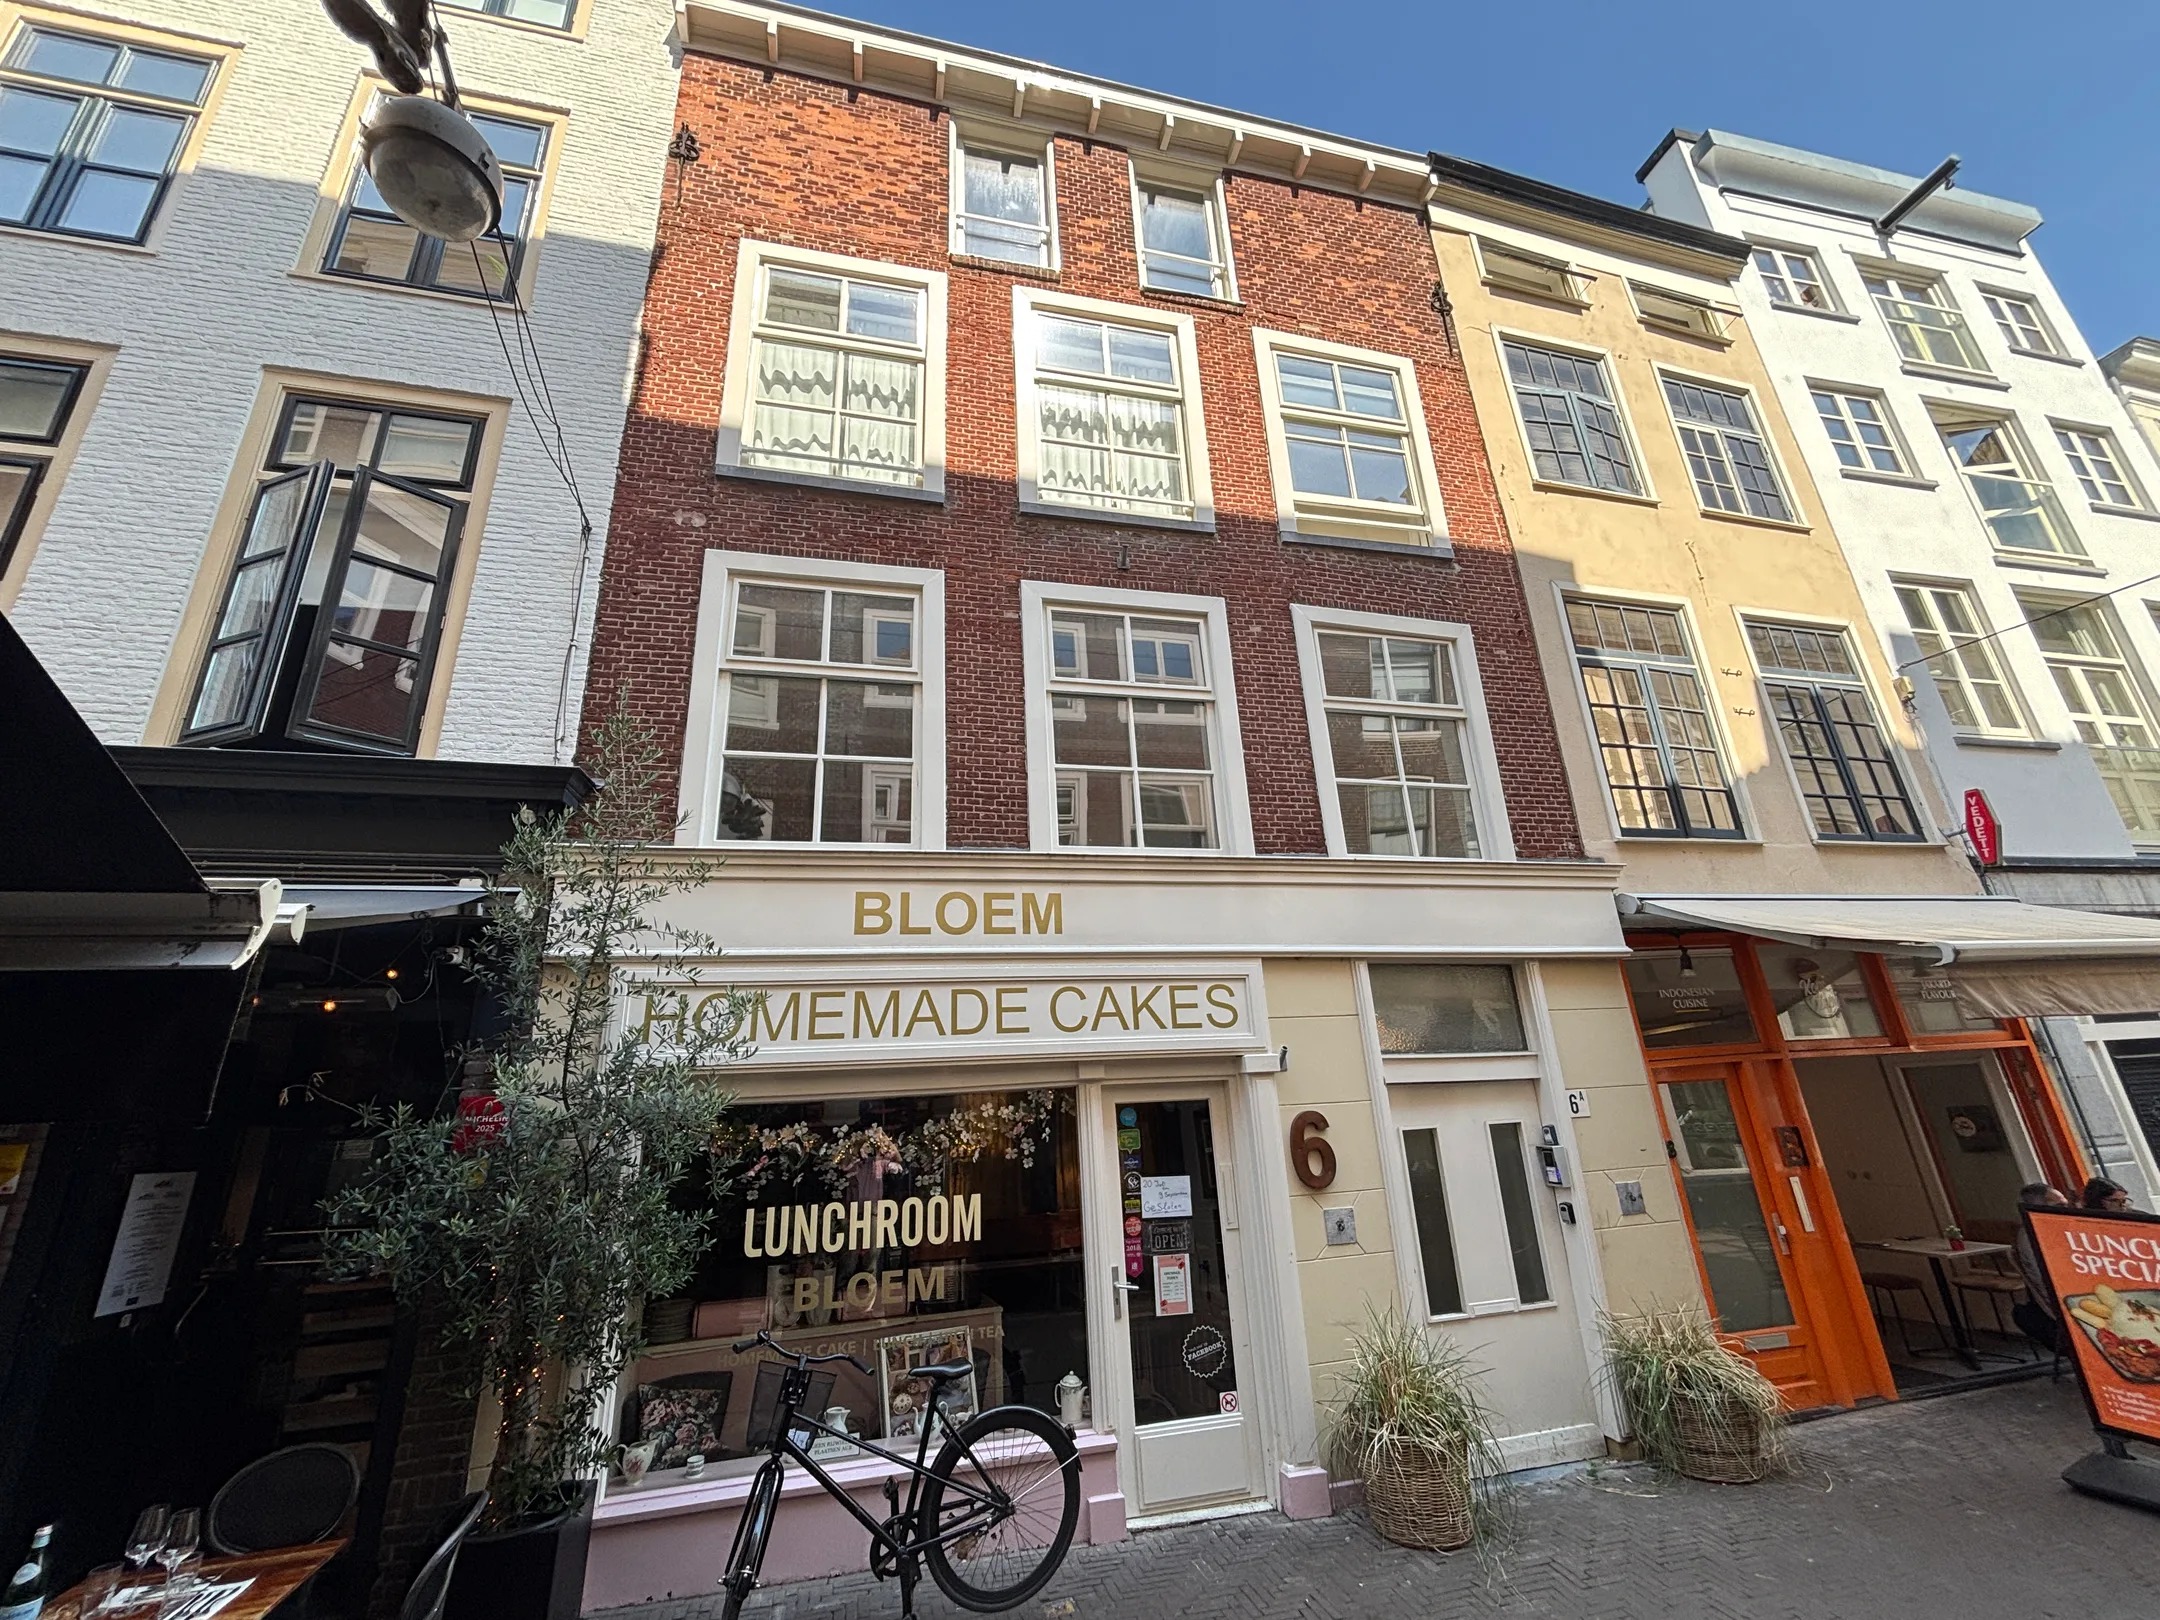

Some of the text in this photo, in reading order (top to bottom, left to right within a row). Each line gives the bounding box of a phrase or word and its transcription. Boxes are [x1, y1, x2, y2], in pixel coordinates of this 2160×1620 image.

[1968, 796, 1990, 857] VEDETT
[854, 891, 1063, 936] BLOEM
[1659, 987, 1715, 998] INDONESIAN
[1672, 998, 1708, 1009] CUISINE
[641, 983, 1240, 1045] HOMEMADE CAKES
[464, 1115, 509, 1123] MICHELIN
[474, 1124, 495, 1133] 2025
[1290, 1111, 1337, 1189] 6
[1143, 1179, 1152, 1188] 20
[743, 1193, 982, 1258] LUNCHROOM
[1155, 1233, 1184, 1249] OPEN
[793, 1266, 945, 1313] BLOEM
[718, 1345, 811, 1368] HOMEMDE
[816, 1340, 857, 1357] CAKE
[978, 1325, 1005, 1340] TEA
[1187, 1341, 1222, 1361] FACEBOOK
[813, 1442, 826, 1450] EEN
